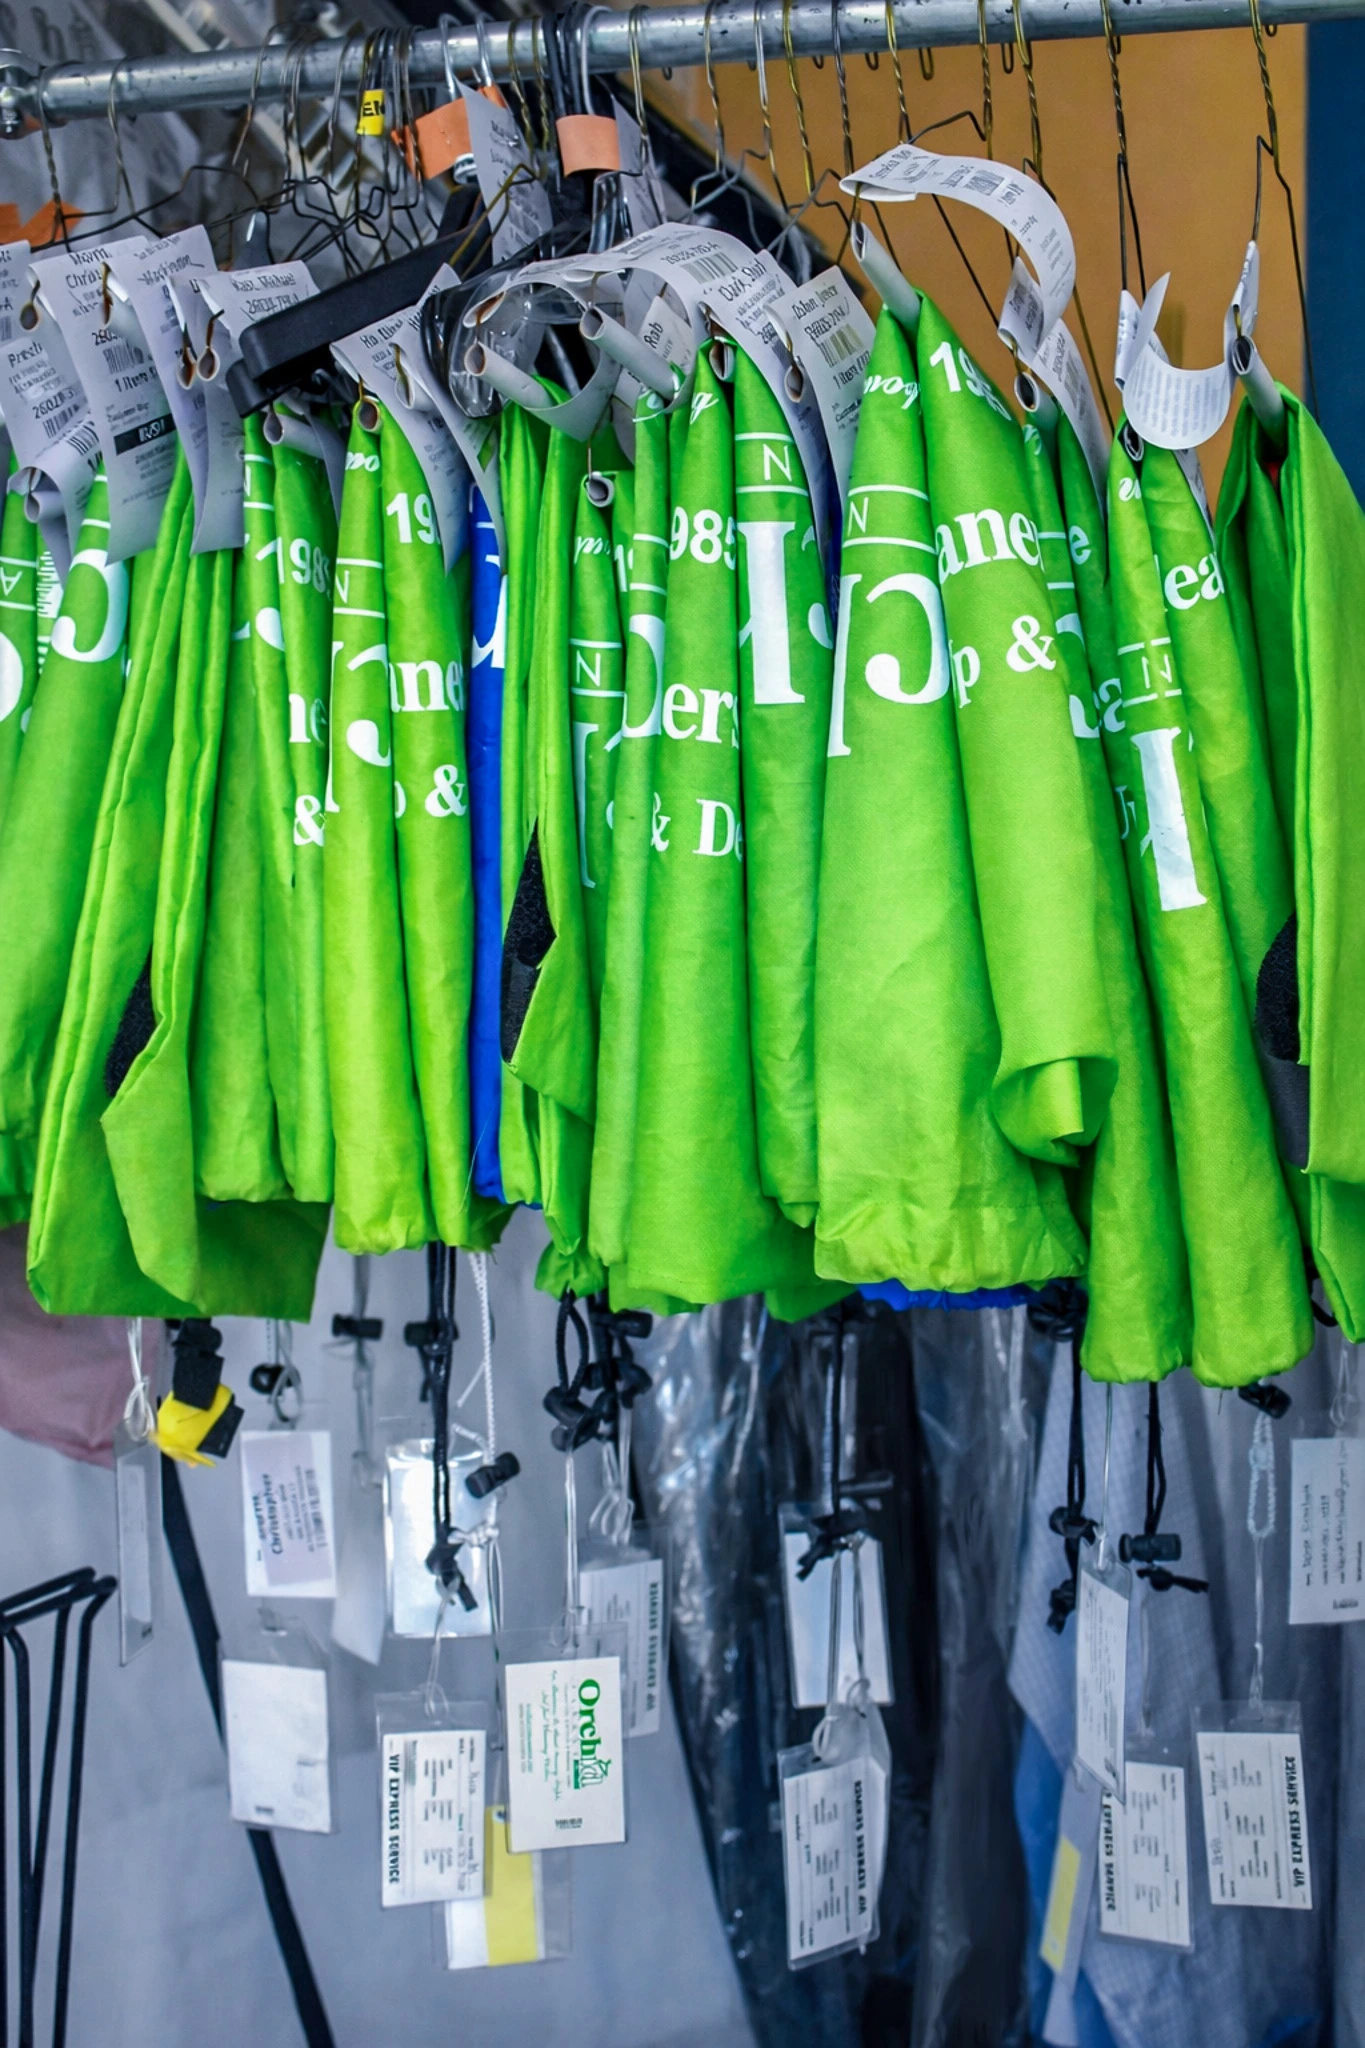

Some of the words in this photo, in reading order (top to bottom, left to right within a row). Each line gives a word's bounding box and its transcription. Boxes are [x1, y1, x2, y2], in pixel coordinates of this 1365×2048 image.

[389, 1754, 400, 1773] VIP
[1285, 1756, 1299, 1805] SERVICE
[389, 1778, 400, 1830] EXPRESS
[389, 1835, 400, 1884] SERVICE
[1289, 1810, 1303, 1863] EXPRESS
[1293, 1868, 1305, 1888] VIP
